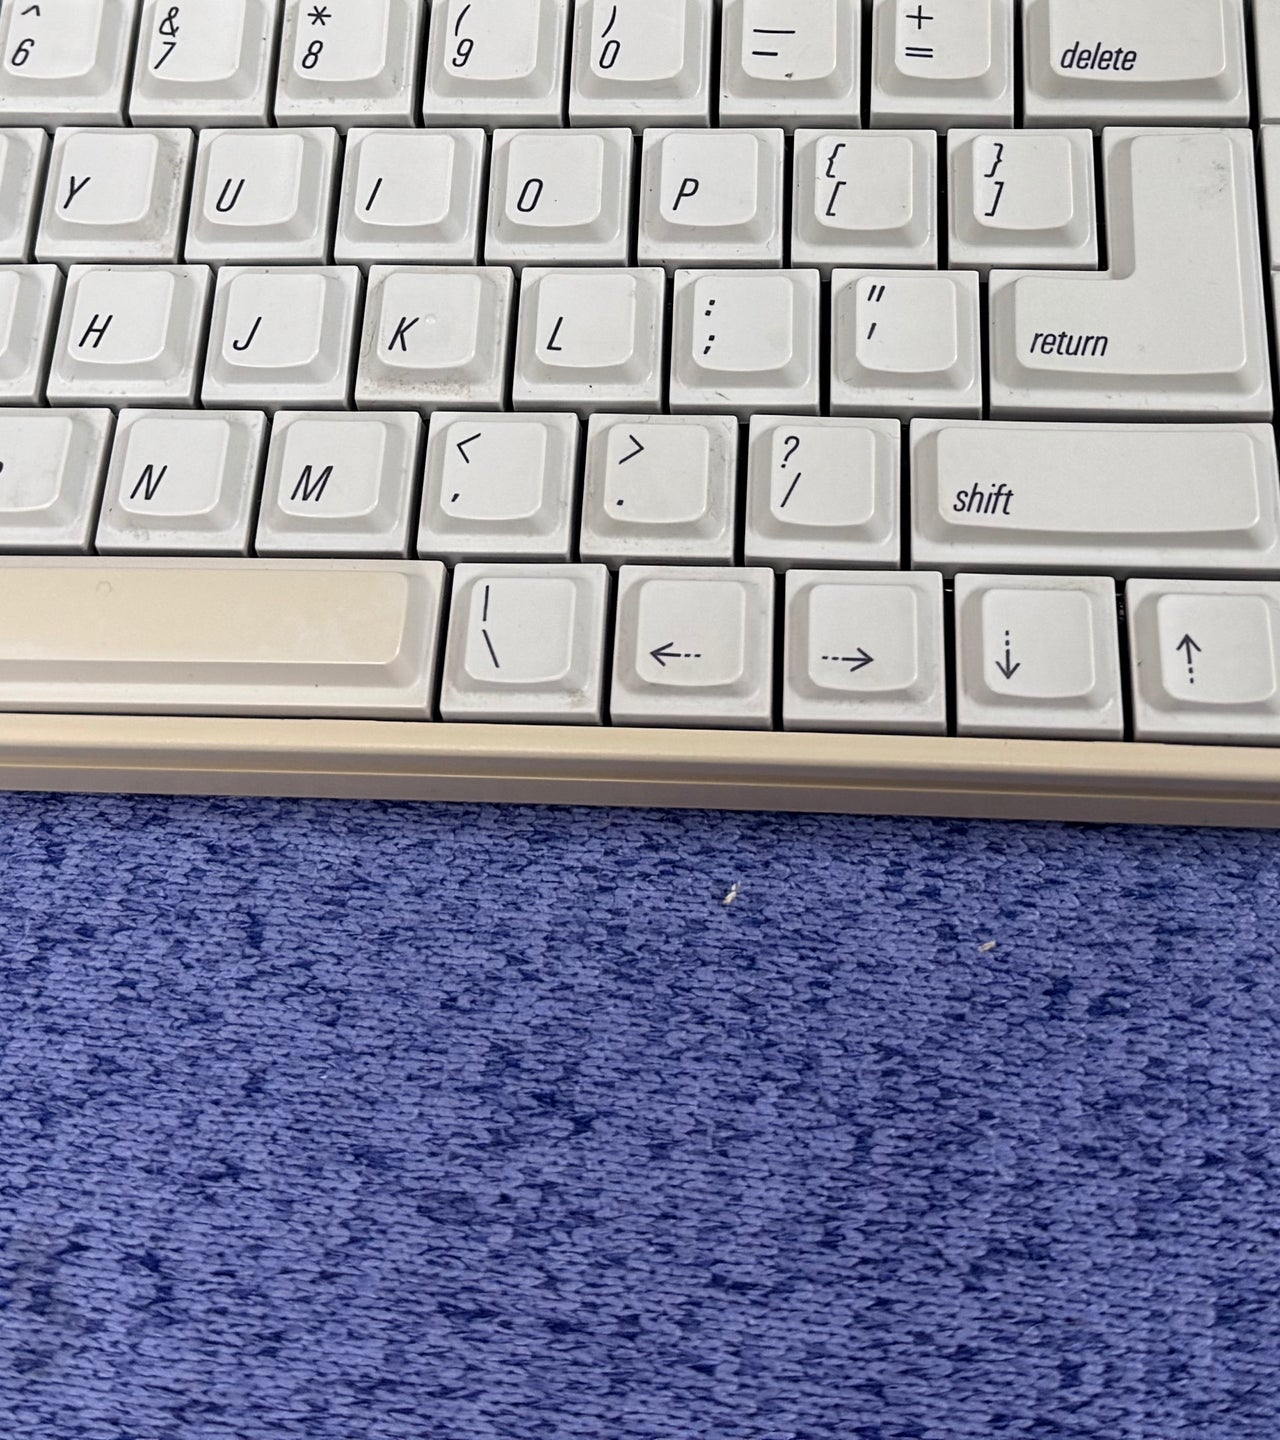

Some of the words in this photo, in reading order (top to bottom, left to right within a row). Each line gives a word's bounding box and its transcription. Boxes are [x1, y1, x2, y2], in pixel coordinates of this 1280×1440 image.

[158, 6, 180, 38] &
[454, 3, 471, 37] (
[601, 5, 617, 39] )
[905, 4, 934, 30] +
[11, 38, 35, 67] 6
[153, 41, 177, 70] 7
[301, 39, 324, 70] 8
[451, 38, 474, 68] 9
[598, 39, 621, 70] 0
[1060, 40, 1138, 71] delete
[825, 143, 847, 179] {
[983, 142, 1004, 178] }
[63, 175, 91, 210] Y
[215, 178, 246, 213] U
[365, 177, 383, 211] I
[516, 178, 544, 213] O
[672, 177, 700, 211] P
[825, 180, 847, 217] [
[984, 180, 1005, 217] ]
[78, 313, 114, 349] H
[232, 316, 262, 351] J
[387, 316, 420, 352] K
[546, 316, 564, 351] L
[1029, 331, 1109, 357] return
[456, 432, 482, 464] <
[618, 434, 645, 465] >
[780, 435, 800, 469] ?
[129, 464, 168, 501] N
[290, 464, 334, 502] M
[780, 472, 802, 508] /
[952, 482, 1015, 516] shift
[481, 628, 500, 669] \
